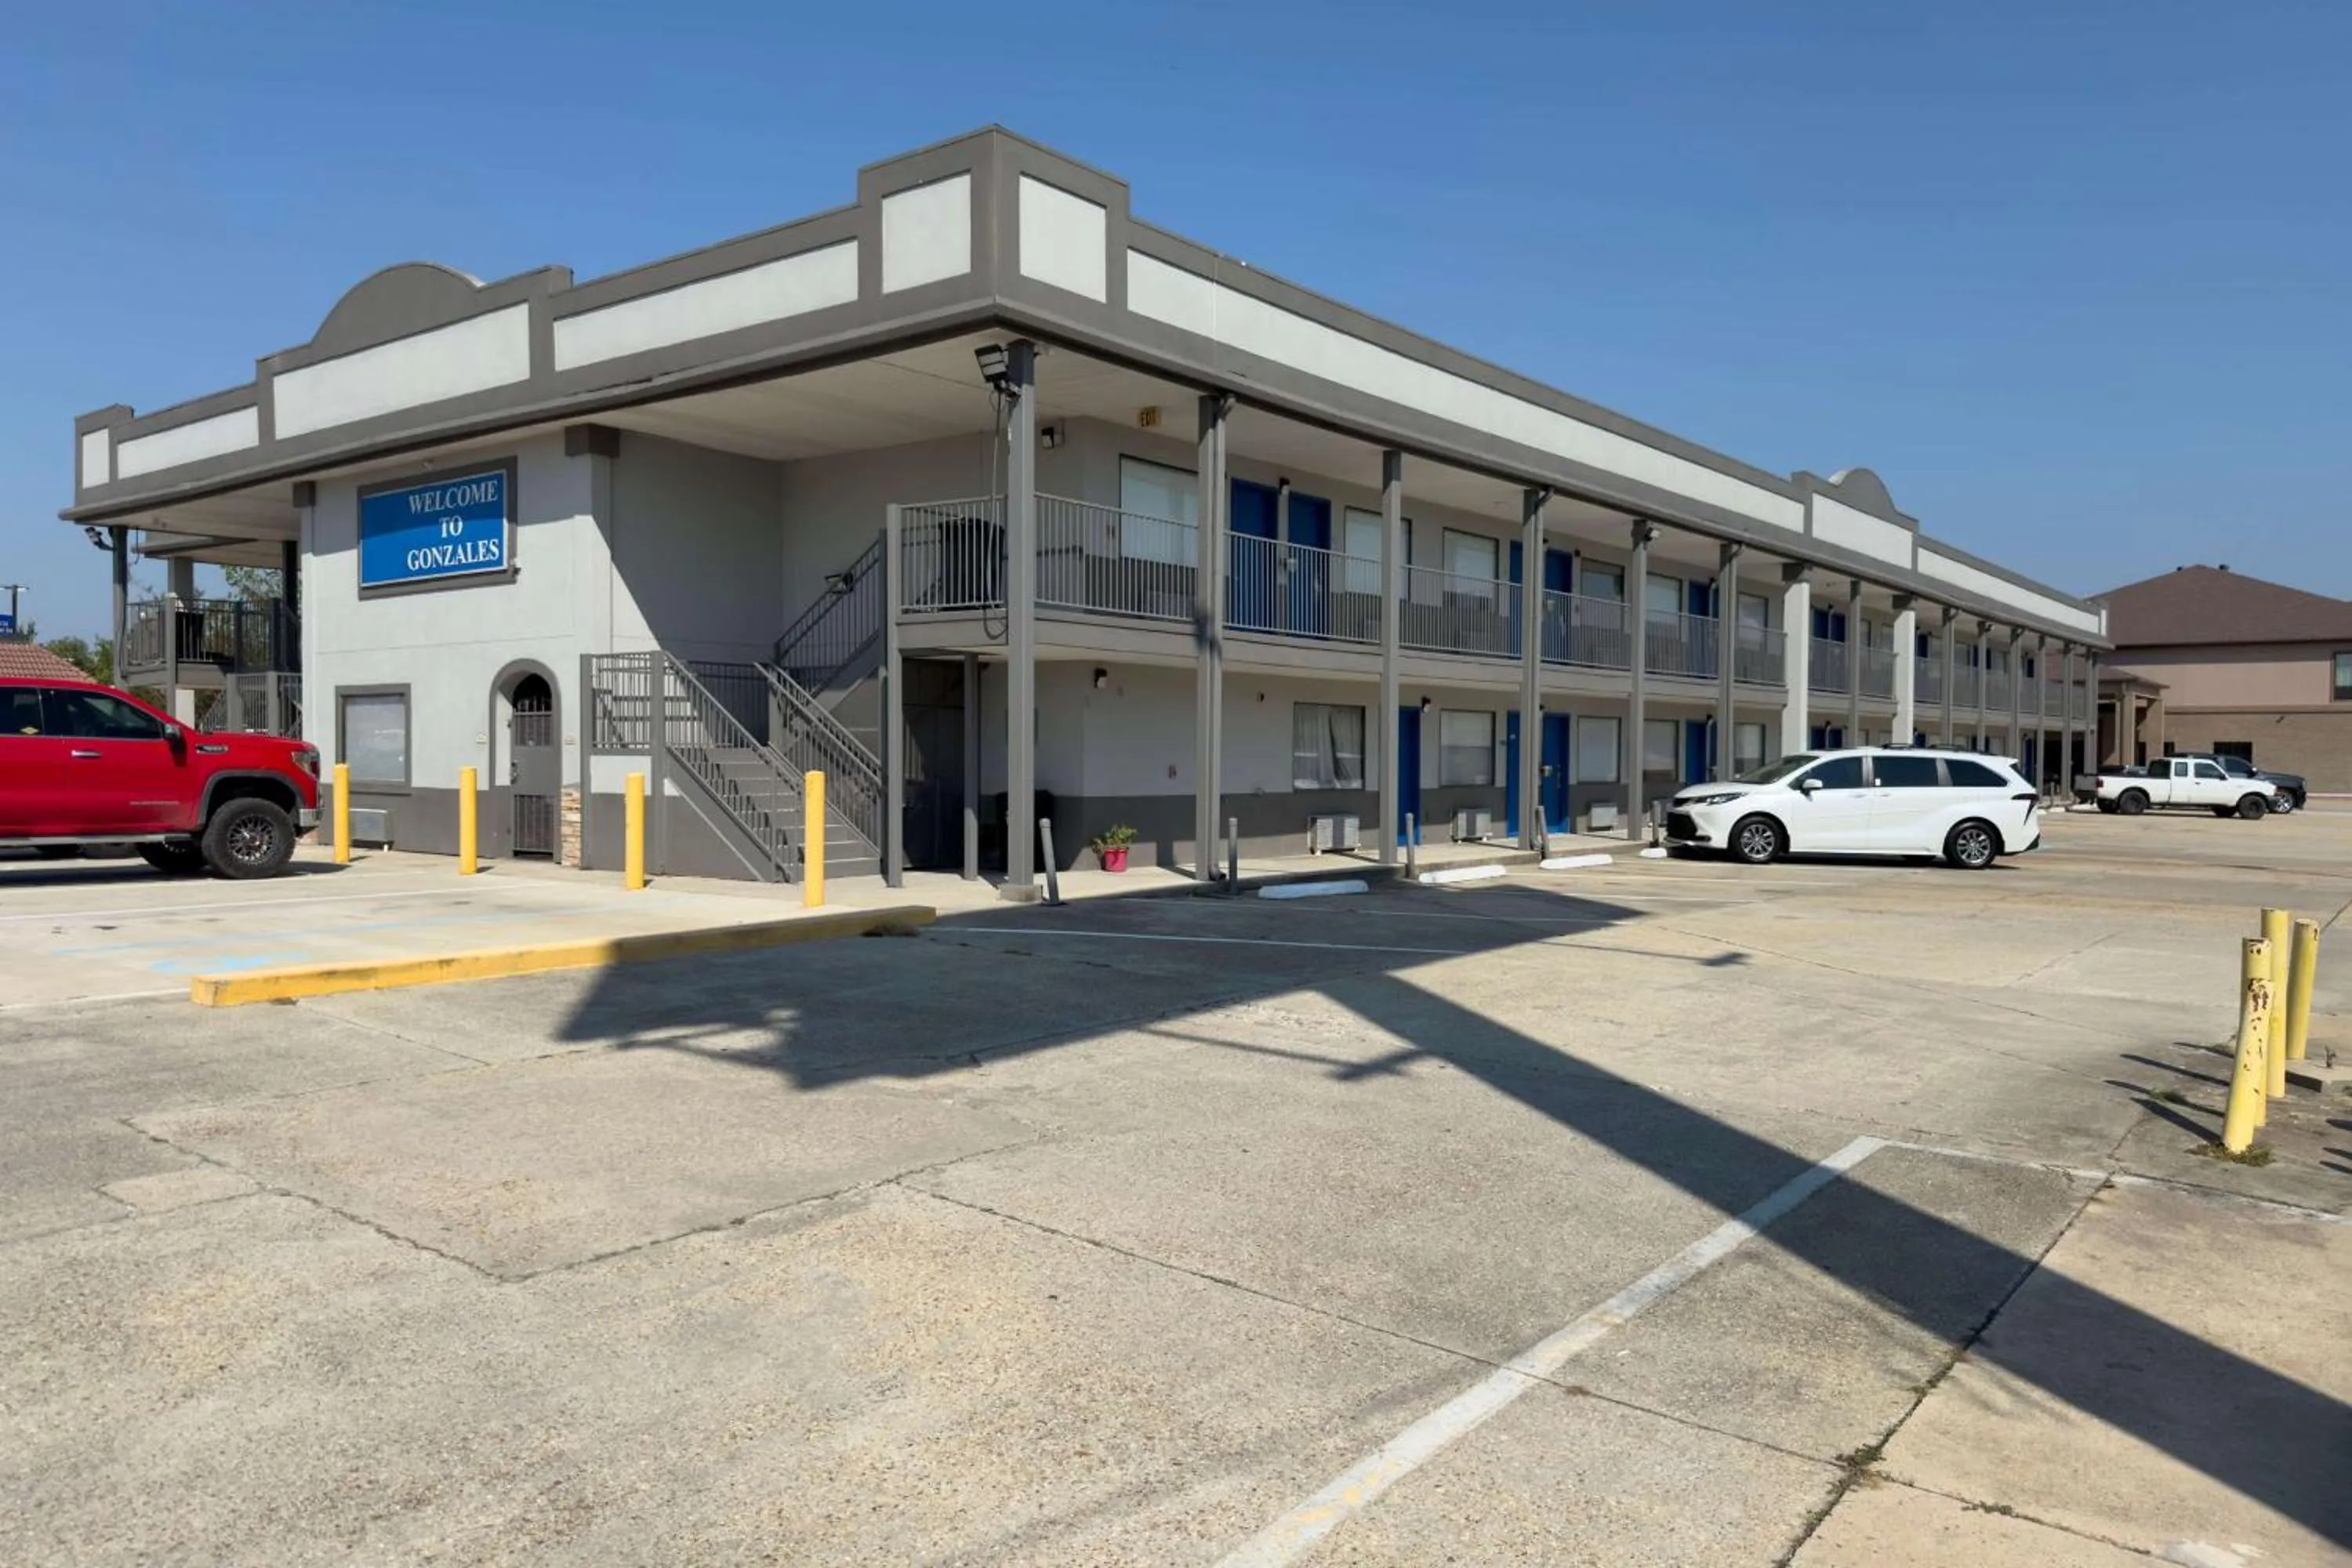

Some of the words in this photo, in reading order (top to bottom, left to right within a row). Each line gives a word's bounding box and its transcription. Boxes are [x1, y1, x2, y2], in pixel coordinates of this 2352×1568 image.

[409, 481, 498, 514] WELCOME
[439, 515, 463, 538] TO
[407, 539, 499, 571] GONZALES
